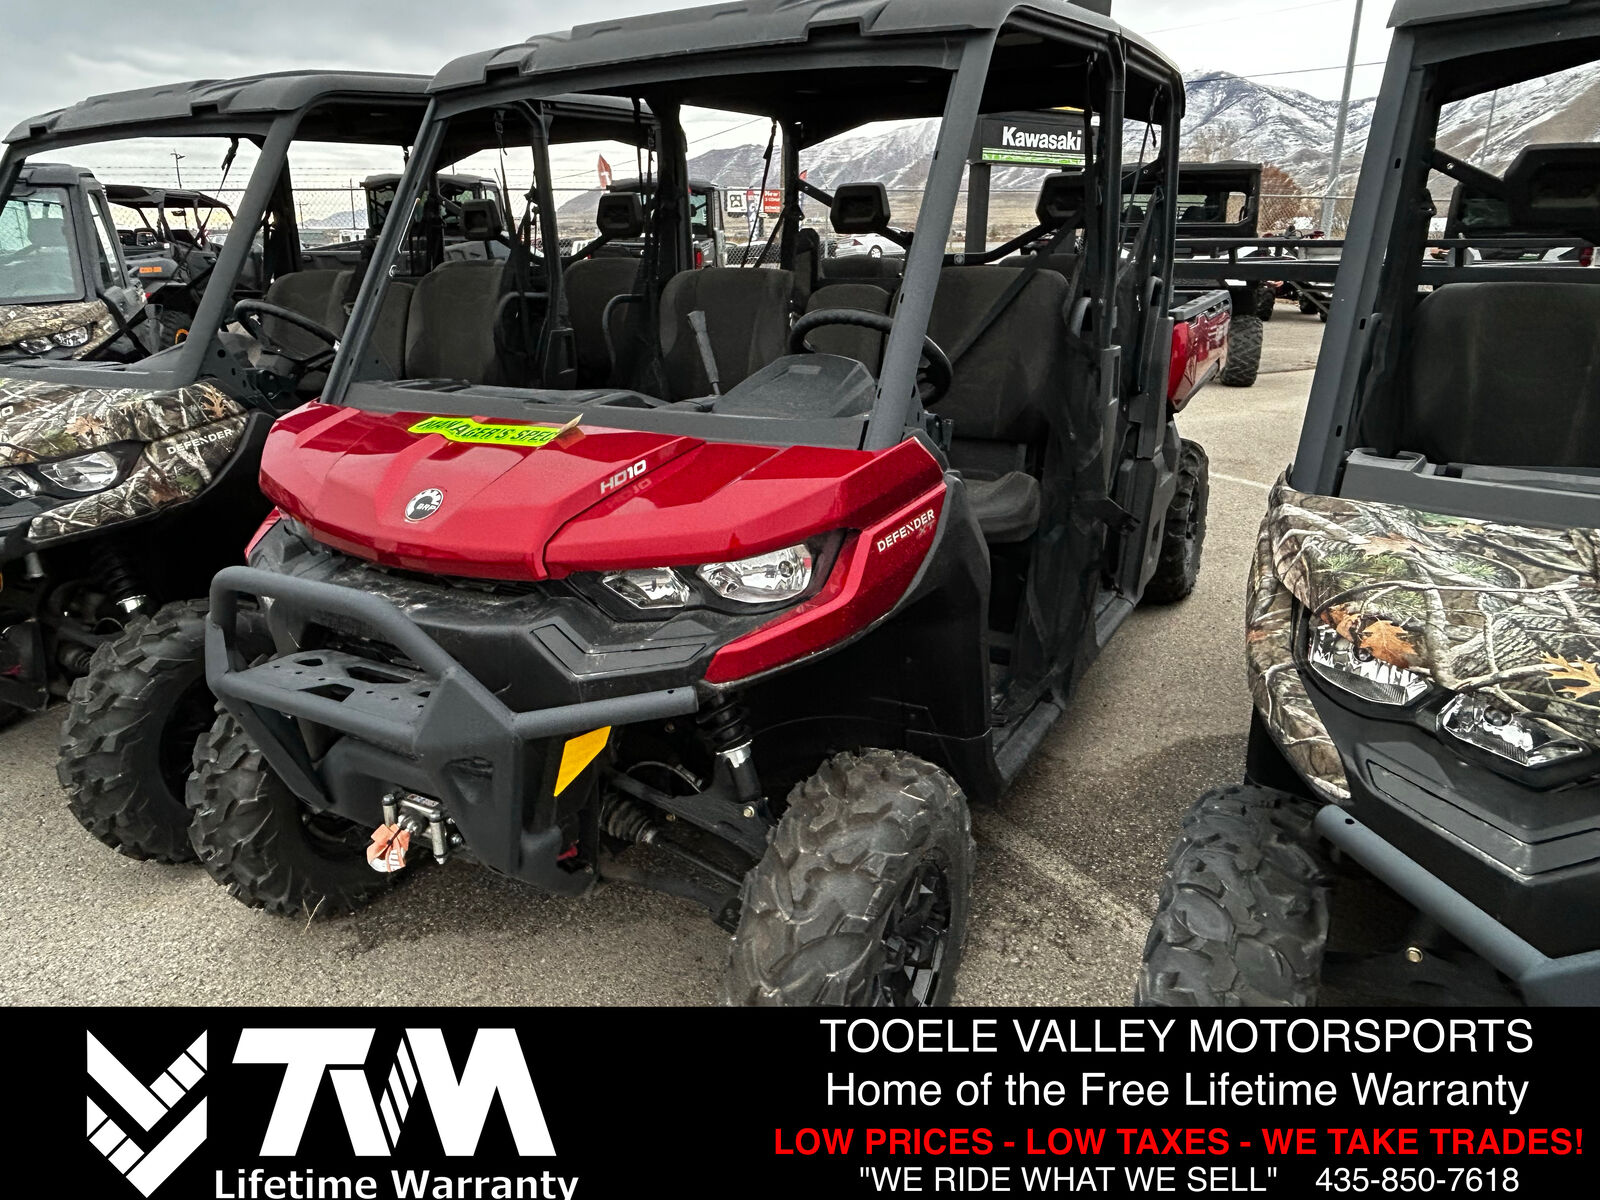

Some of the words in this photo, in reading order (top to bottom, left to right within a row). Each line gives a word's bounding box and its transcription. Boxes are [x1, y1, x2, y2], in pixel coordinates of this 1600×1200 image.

[1002, 126, 1082, 150] Kawasaki
[166, 429, 233, 455] DEFENDER
[416, 420, 516, 440] MANAGER'S
[600, 459, 647, 494] HD10
[416, 503, 438, 511] BRP
[876, 509, 935, 552] DEFENDER
